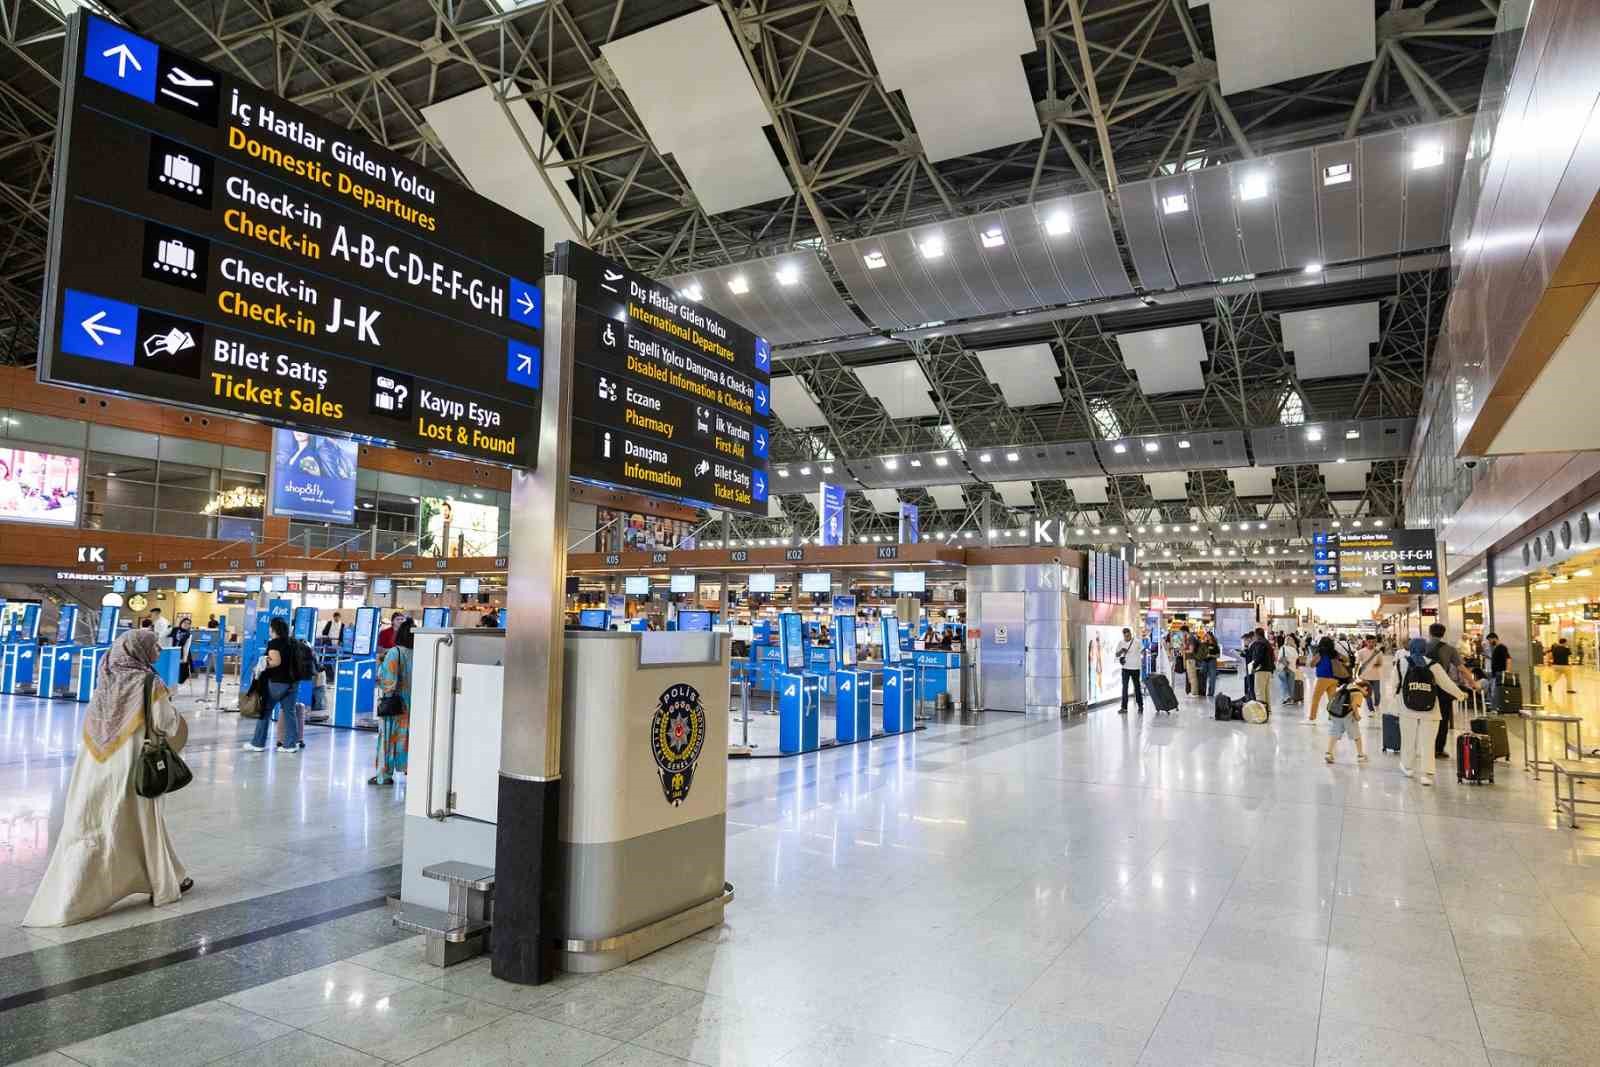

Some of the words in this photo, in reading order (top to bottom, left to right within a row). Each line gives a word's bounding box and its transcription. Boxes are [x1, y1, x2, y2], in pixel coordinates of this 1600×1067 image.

[231, 88, 251, 126] İç
[258, 106, 325, 153] Hatlar
[331, 141, 387, 182] Giden
[391, 167, 435, 204] Yolcu
[228, 126, 332, 187] Domestic
[338, 172, 436, 231] Departures
[225, 176, 322, 229] Check-in
[223, 208, 320, 260] Check-in
[220, 257, 317, 305] Check-in
[330, 225, 503, 317] A-B-C-D-E-F-G-H
[218, 290, 316, 335] Check-in
[325, 297, 381, 346] J-K
[630, 281, 646, 304] Dış
[649, 290, 678, 315] Hatlar
[680, 305, 704, 328] Giden
[706, 317, 726, 338] Yolcu
[629, 302, 691, 341] International
[692, 330, 734, 362] Departures
[214, 339, 269, 372] Bilet
[276, 353, 328, 390] Satış
[628, 334, 660, 359] Engelli
[661, 347, 684, 368] Yolcu
[686, 357, 718, 383] Danışma
[720, 372, 725, 386] &
[727, 376, 754, 399] Check-in
[211, 372, 283, 408] Ticket
[289, 392, 344, 419] Sales
[626, 387, 660, 411] Eczane
[627, 355, 668, 382] Disabled
[670, 368, 716, 401] Information
[717, 390, 723, 403] &
[724, 393, 752, 416] Check-in
[420, 389, 464, 421] Kayıp
[468, 402, 501, 427] Eşya
[625, 408, 674, 439] Pharmacy
[418, 417, 452, 442] Lost
[457, 428, 468, 445] &
[473, 430, 516, 455] Found
[715, 413, 725, 433] İlk
[726, 421, 750, 442] Yardım
[625, 440, 668, 464] Danışma
[715, 436, 732, 453] First
[733, 443, 745, 459] Aid
[284, 480, 324, 498] shop&fly
[624, 461, 682, 488] Information
[714, 464, 732, 481] Bilet
[733, 470, 750, 489] Satış
[714, 483, 735, 500] Ticket
[735, 489, 751, 504] Sales
[1035, 520, 1053, 543] K
[606, 555, 620, 565] K05
[653, 553, 667, 563] K04
[731, 552, 746, 561] K03
[787, 550, 802, 560] K02
[879, 547, 897, 559] K01
[1364, 549, 1433, 560] A-B-C-D-E-F-G-H
[663, 686, 696, 704] POLİS
